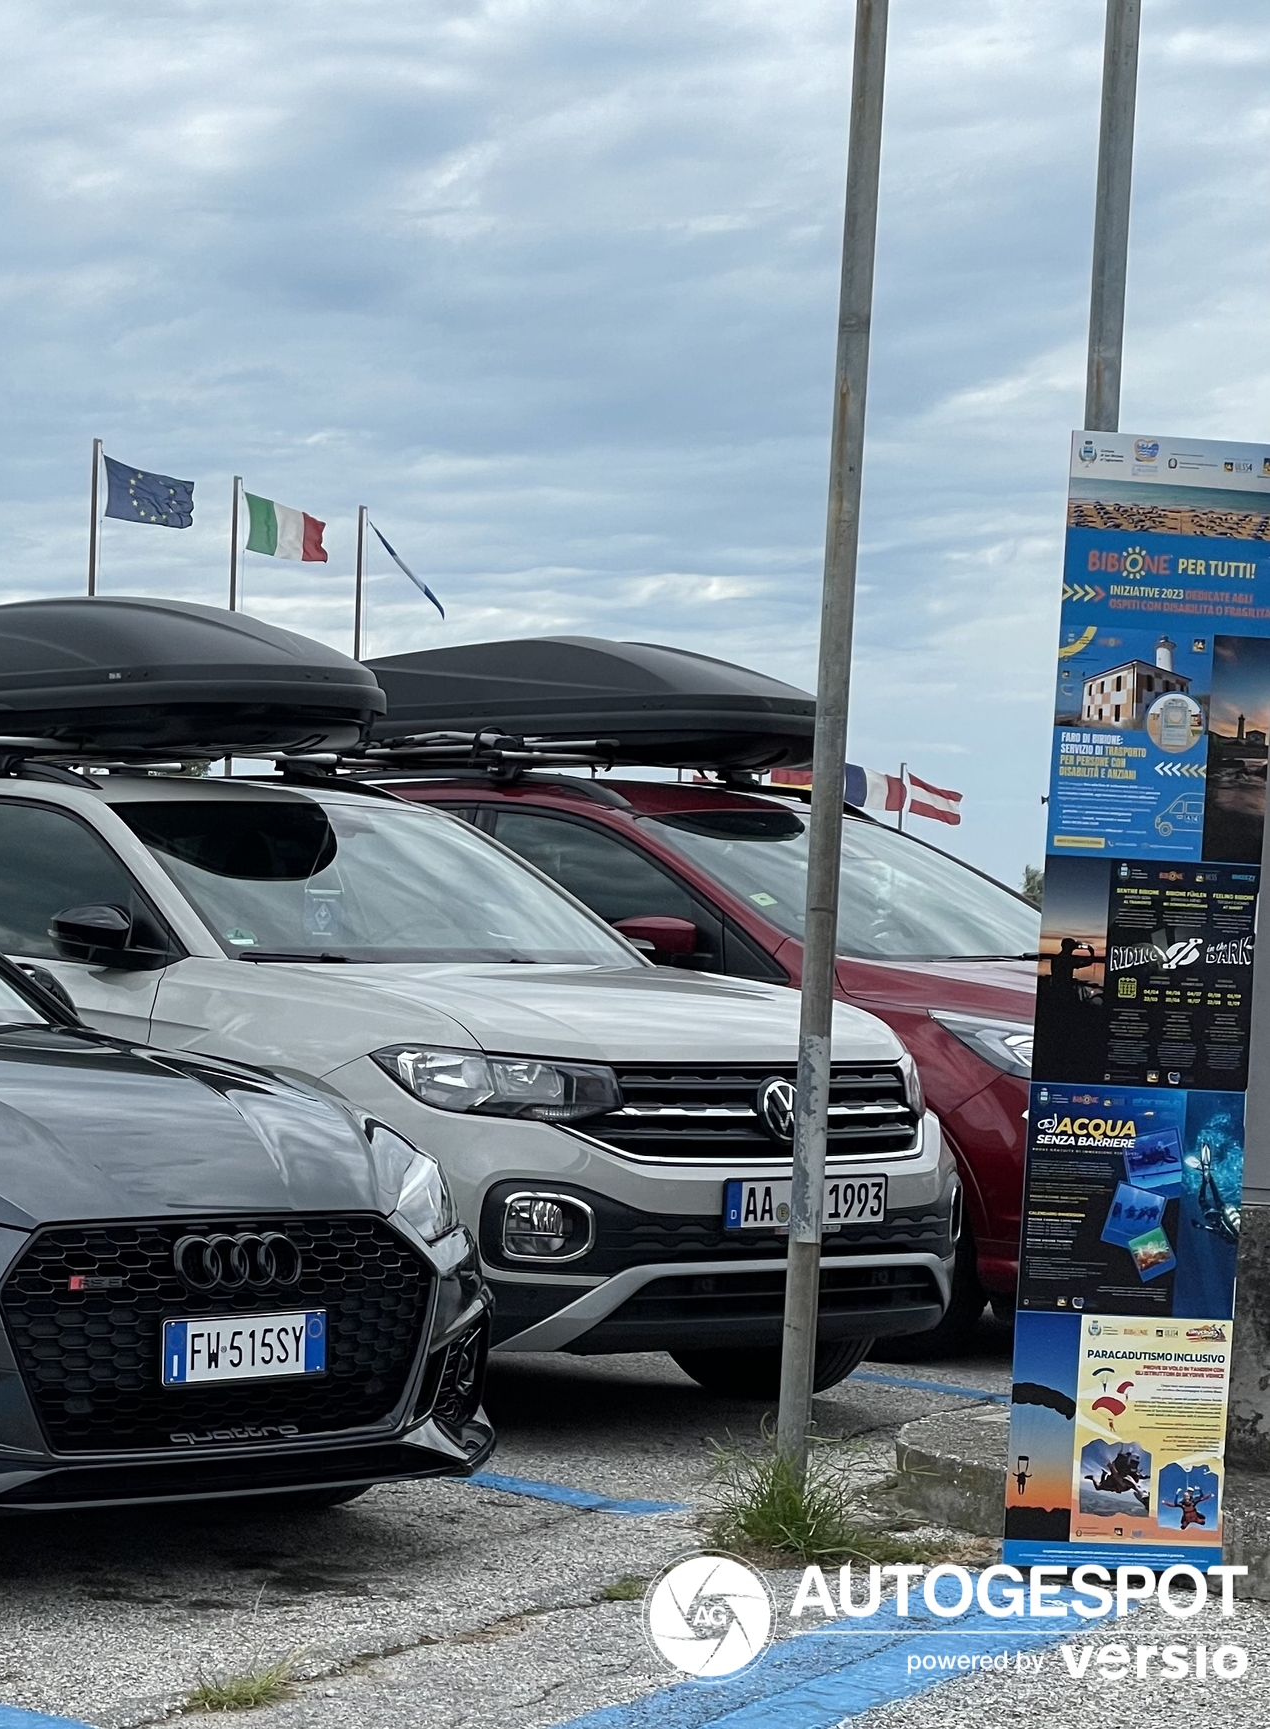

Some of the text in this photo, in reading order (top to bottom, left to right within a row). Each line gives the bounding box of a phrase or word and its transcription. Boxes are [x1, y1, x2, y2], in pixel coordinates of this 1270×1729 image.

[1178, 558, 1206, 576] PER
[1209, 560, 1257, 579] TUTTI!
[1110, 585, 1160, 598] INIZIATIVE
[1161, 588, 1184, 599] 2023
[1141, 602, 1162, 612] CON
[1216, 605, 1223, 616] O
[1061, 732, 1081, 743] FARO
[1082, 733, 1091, 744] DI
[1060, 743, 1093, 755] SERVIZIO
[1094, 745, 1103, 756] DI
[1059, 754, 1074, 765] PER
[1111, 757, 1126, 768] CON
[1101, 768, 1106, 778] E
[1205, 936, 1253, 965] DARK
[1055, 1117, 1137, 1139] ACQUA
[1036, 1134, 1136, 1149] SENZA BARRIERE
[744, 1182, 884, 1222] AA 1993
[190, 1325, 304, 1370] FW 515SY
[1087, 1349, 1225, 1364] PARACADUTISMO INCLUSIVO
[170, 1423, 299, 1445] quattro
